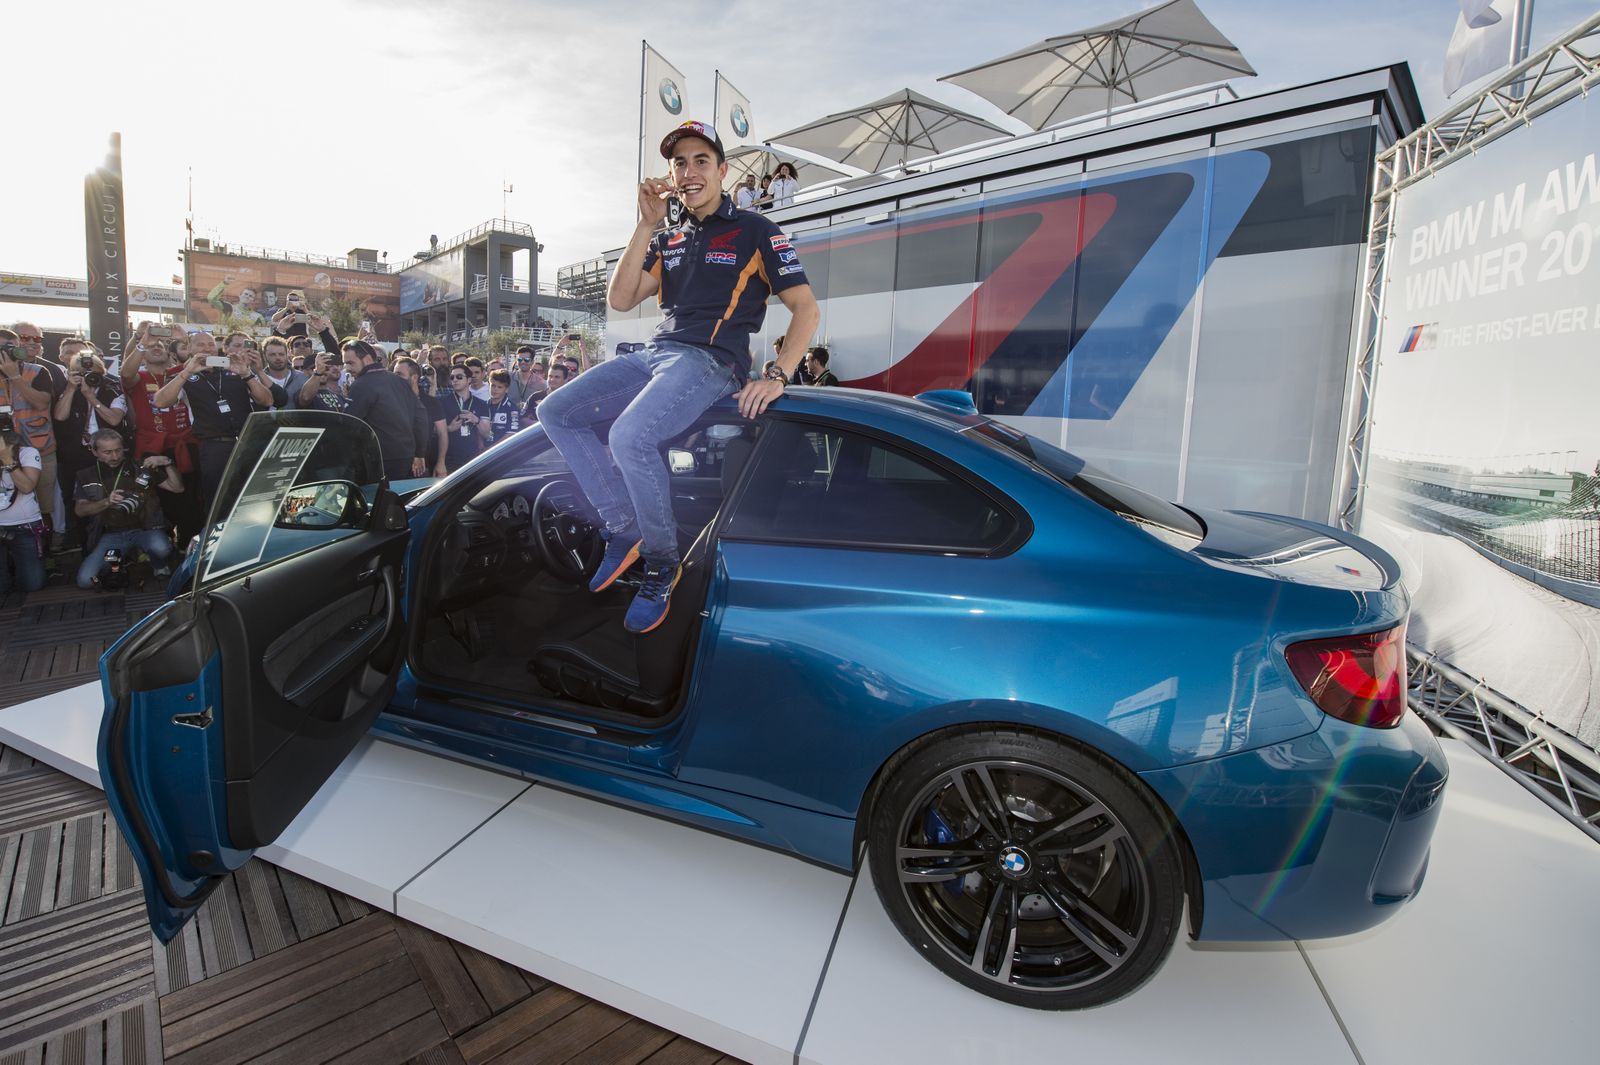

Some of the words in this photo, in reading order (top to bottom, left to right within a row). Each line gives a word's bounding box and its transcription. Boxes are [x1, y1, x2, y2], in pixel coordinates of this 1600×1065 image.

[103, 183, 118, 259] CIRCUIT
[1409, 200, 1486, 266] BMW
[1490, 183, 1526, 239] M
[705, 252, 737, 265] HRC
[1405, 241, 1528, 312] WINNER
[1537, 222, 1600, 282] 20
[106, 272, 119, 313] PRIX
[1442, 325, 1472, 347] THE
[1475, 306, 1588, 345] FIRST-EVER
